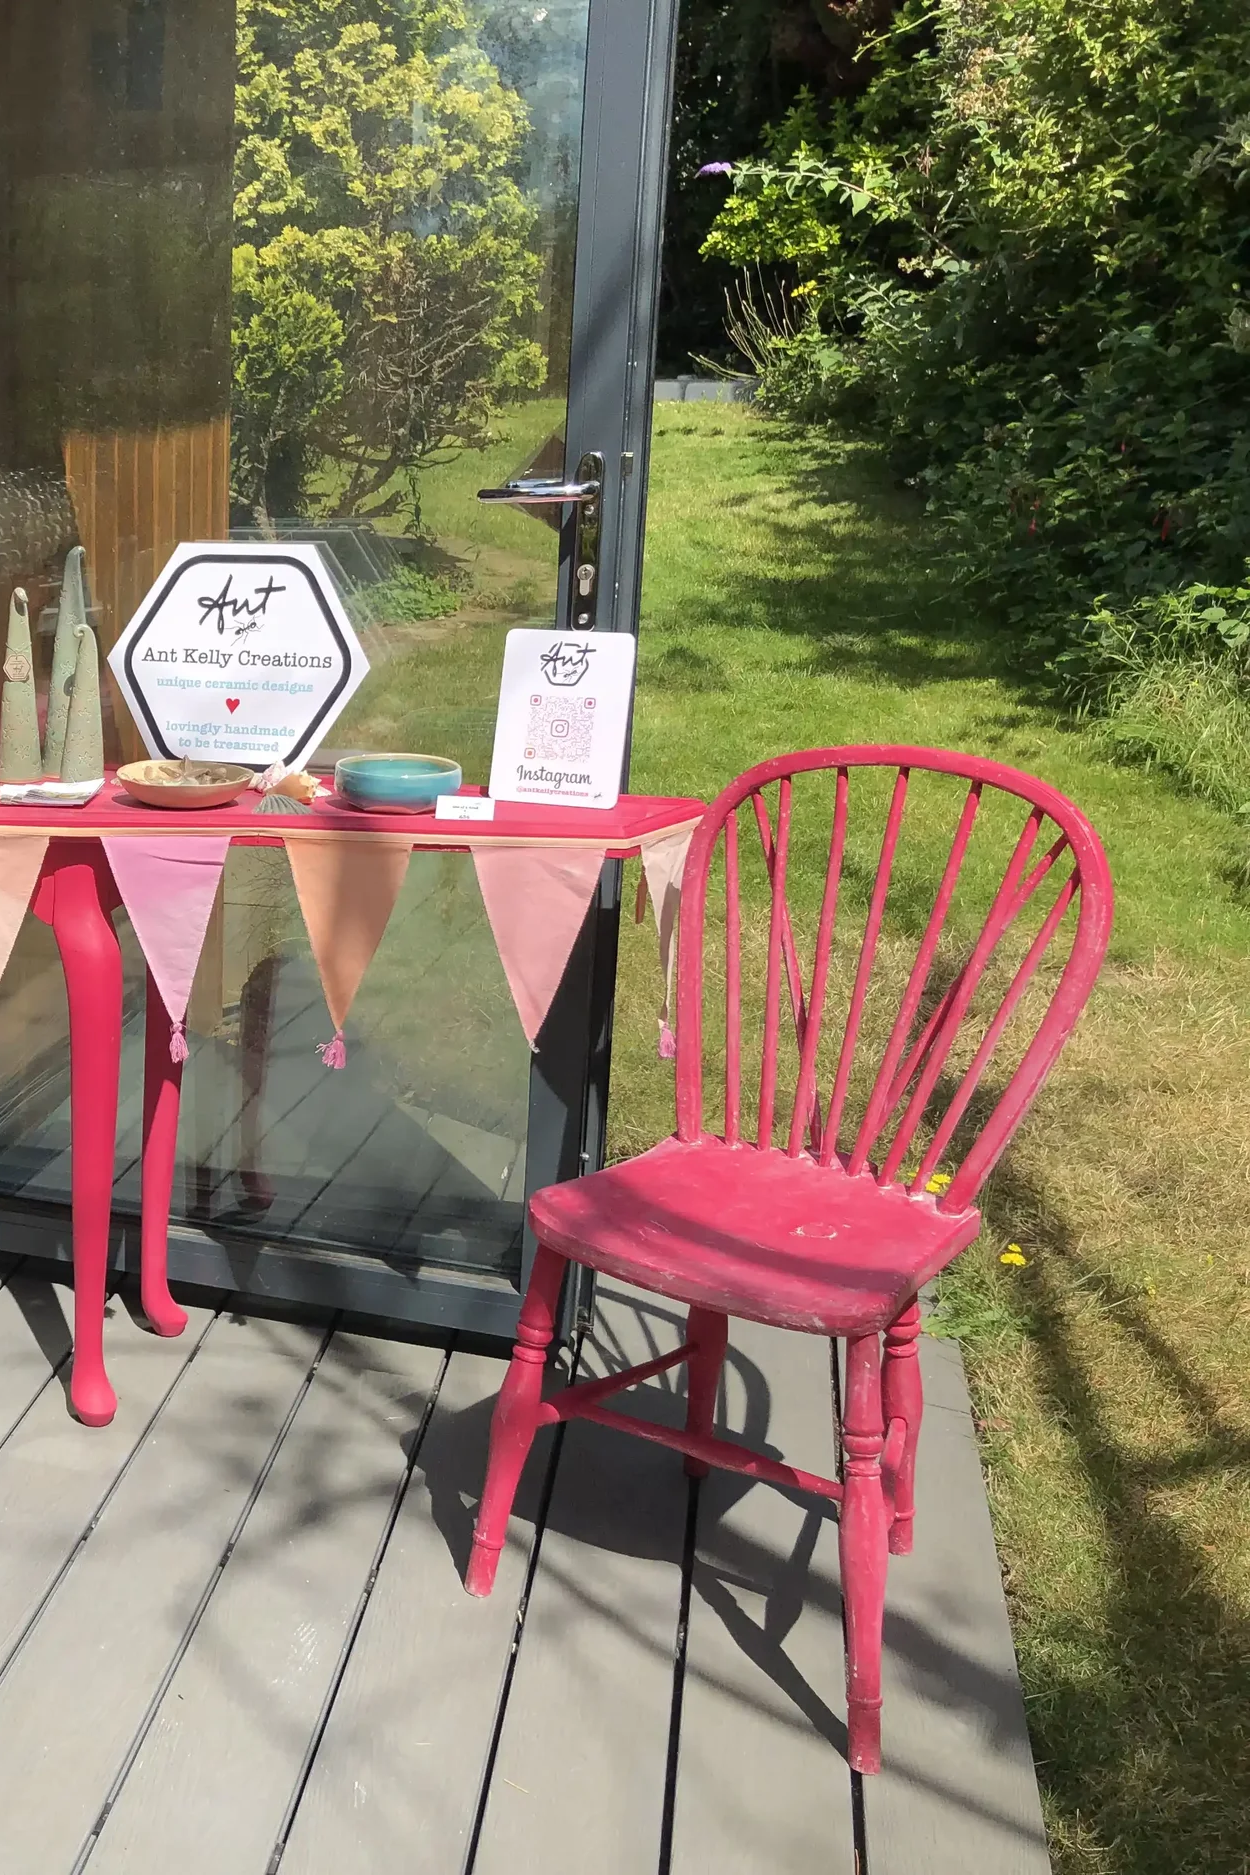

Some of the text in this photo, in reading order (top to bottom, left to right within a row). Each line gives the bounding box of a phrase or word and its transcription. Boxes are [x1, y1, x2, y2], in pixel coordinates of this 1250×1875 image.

[197, 574, 286, 635] Ant
[141, 647, 332, 669] Ant Kelly Creations
[540, 641, 596, 677] Ant
[156, 675, 314, 694] unique ceramic designs
[165, 720, 295, 737] lovingly handmade
[178, 736, 279, 752] to be treasured
[516, 764, 592, 789] Instagram
